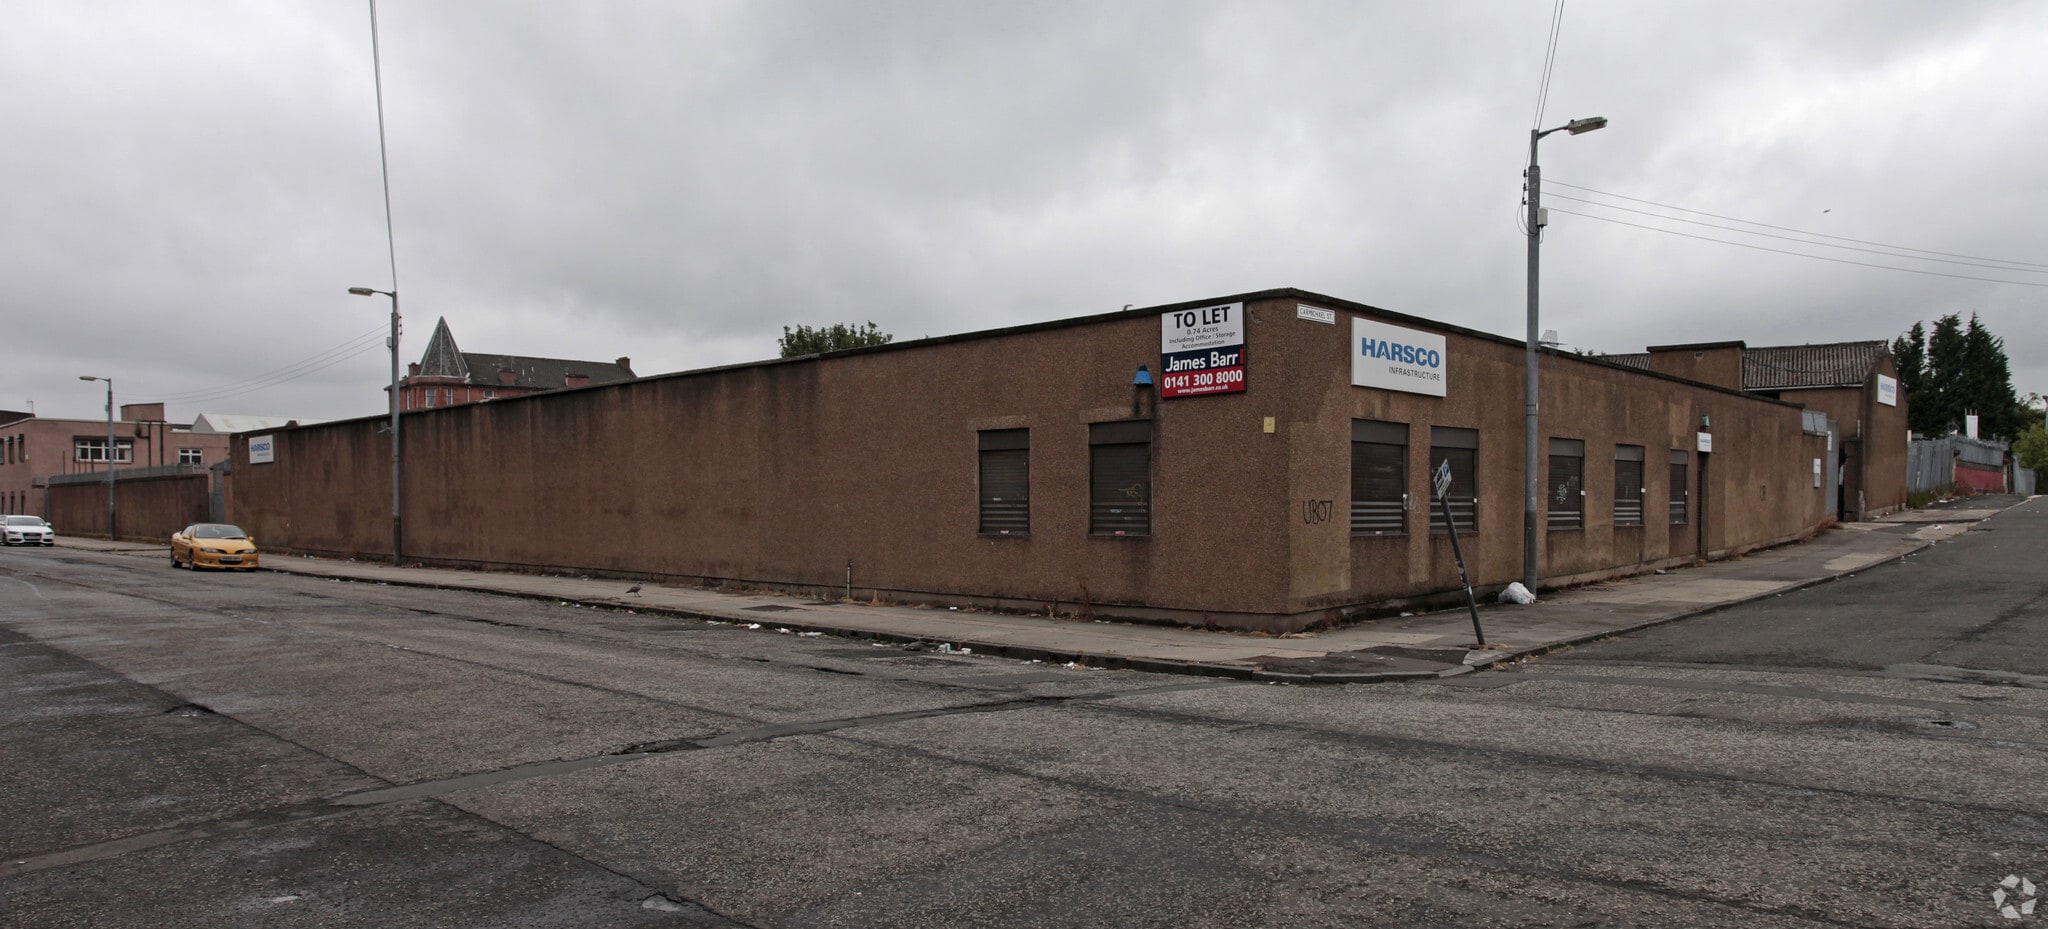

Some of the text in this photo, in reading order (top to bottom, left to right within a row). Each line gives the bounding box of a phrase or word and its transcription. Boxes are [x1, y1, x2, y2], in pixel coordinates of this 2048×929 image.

[1174, 306, 1230, 329] TO LET
[1299, 307, 1326, 319] CARMICHAEL
[1169, 336, 1194, 344] Including
[1182, 340, 1225, 349] Accommodation
[1361, 337, 1440, 368] HARSCO
[1165, 351, 1239, 372] James Barr
[1164, 369, 1243, 389] 0141 300 8000
[1388, 366, 1441, 381] INFRASTRUCTURE
[1177, 384, 1228, 393] www.jamesbarr.co.uk
